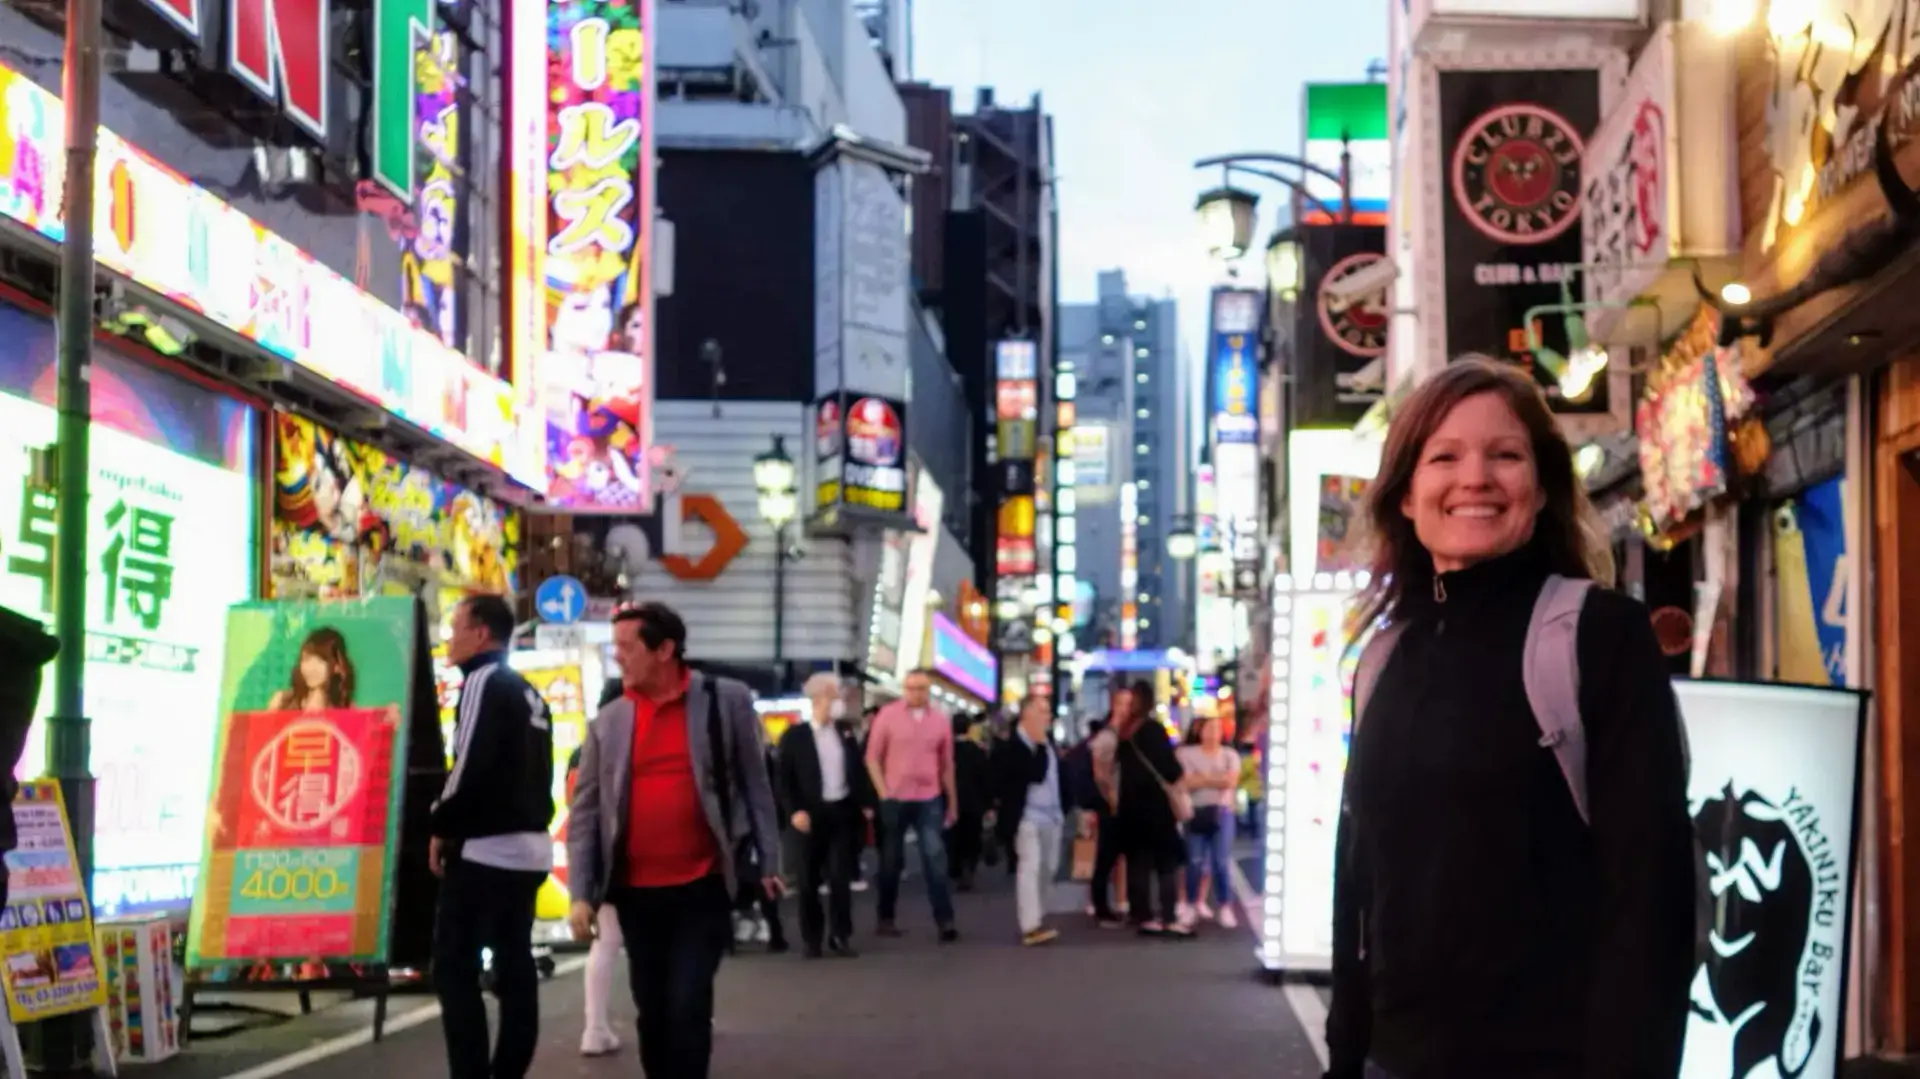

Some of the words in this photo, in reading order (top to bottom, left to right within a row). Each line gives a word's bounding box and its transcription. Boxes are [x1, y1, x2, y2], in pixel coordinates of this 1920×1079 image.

[548, 12, 640, 255] ールス
[1473, 189, 1576, 232] TOKYO
[280, 724, 338, 833] 早得
[1782, 785, 1839, 928] YAKINIKU
[1802, 940, 1834, 998] Bar
